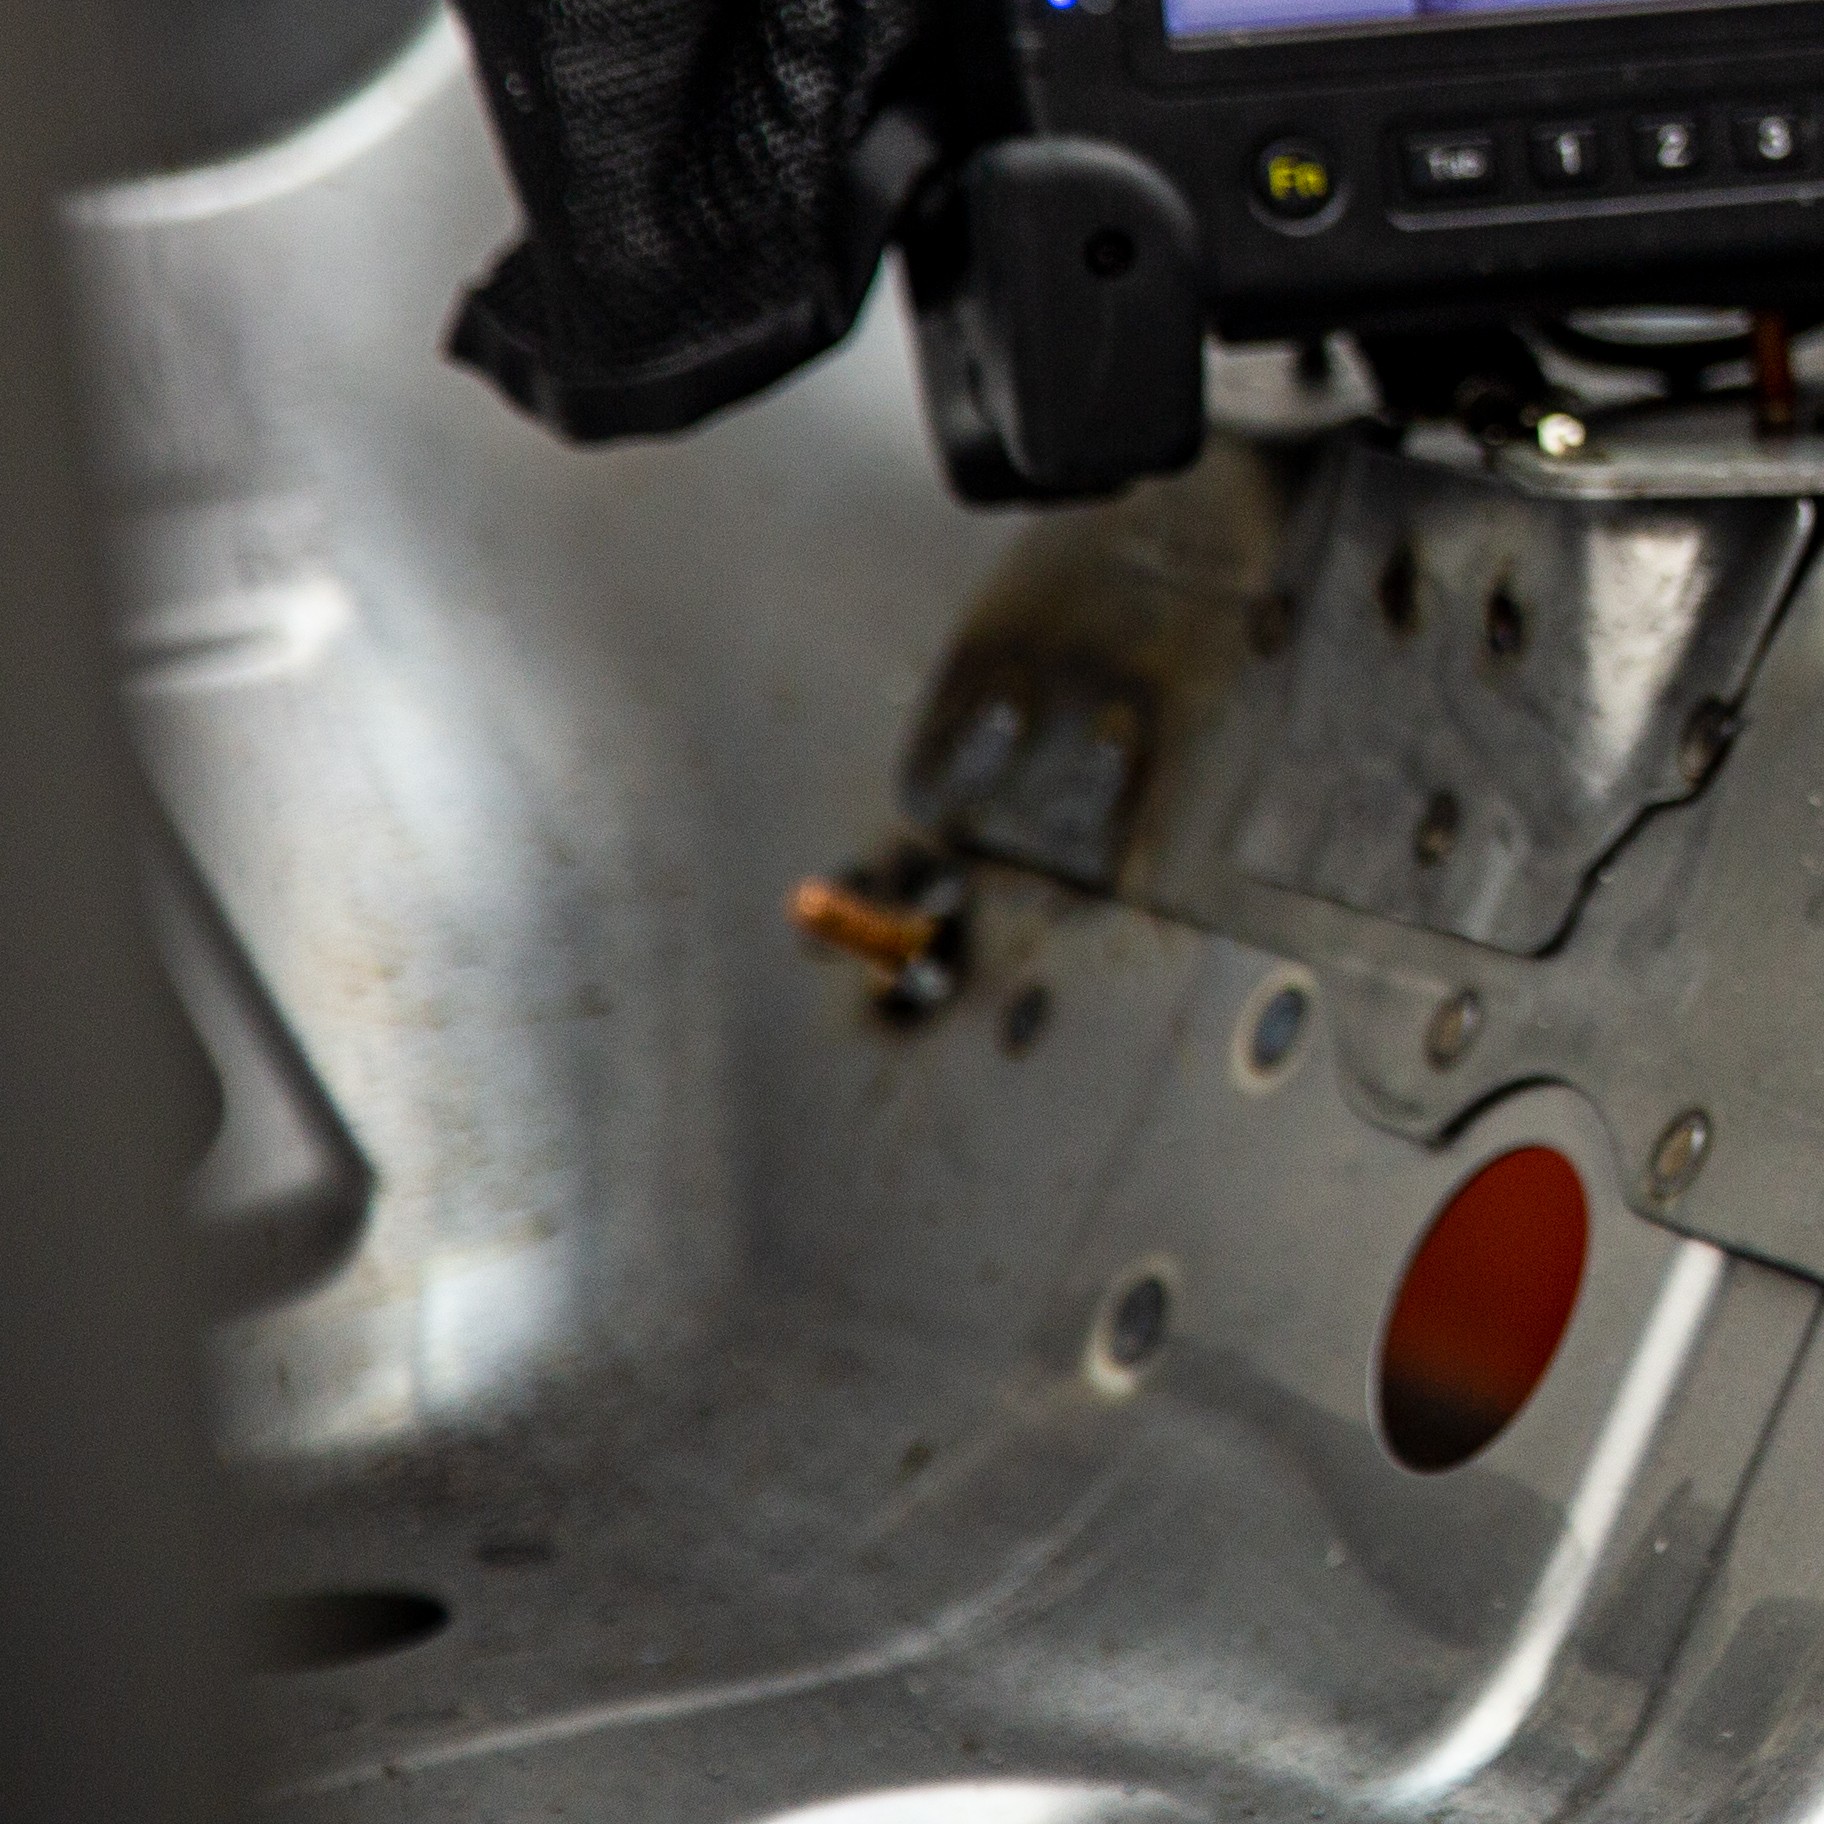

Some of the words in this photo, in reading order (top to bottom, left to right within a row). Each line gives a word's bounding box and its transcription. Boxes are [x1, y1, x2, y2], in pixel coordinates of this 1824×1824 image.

[1557, 131, 1582, 175] 1
[1656, 123, 1691, 168] 2
[1758, 115, 1793, 160] 3
